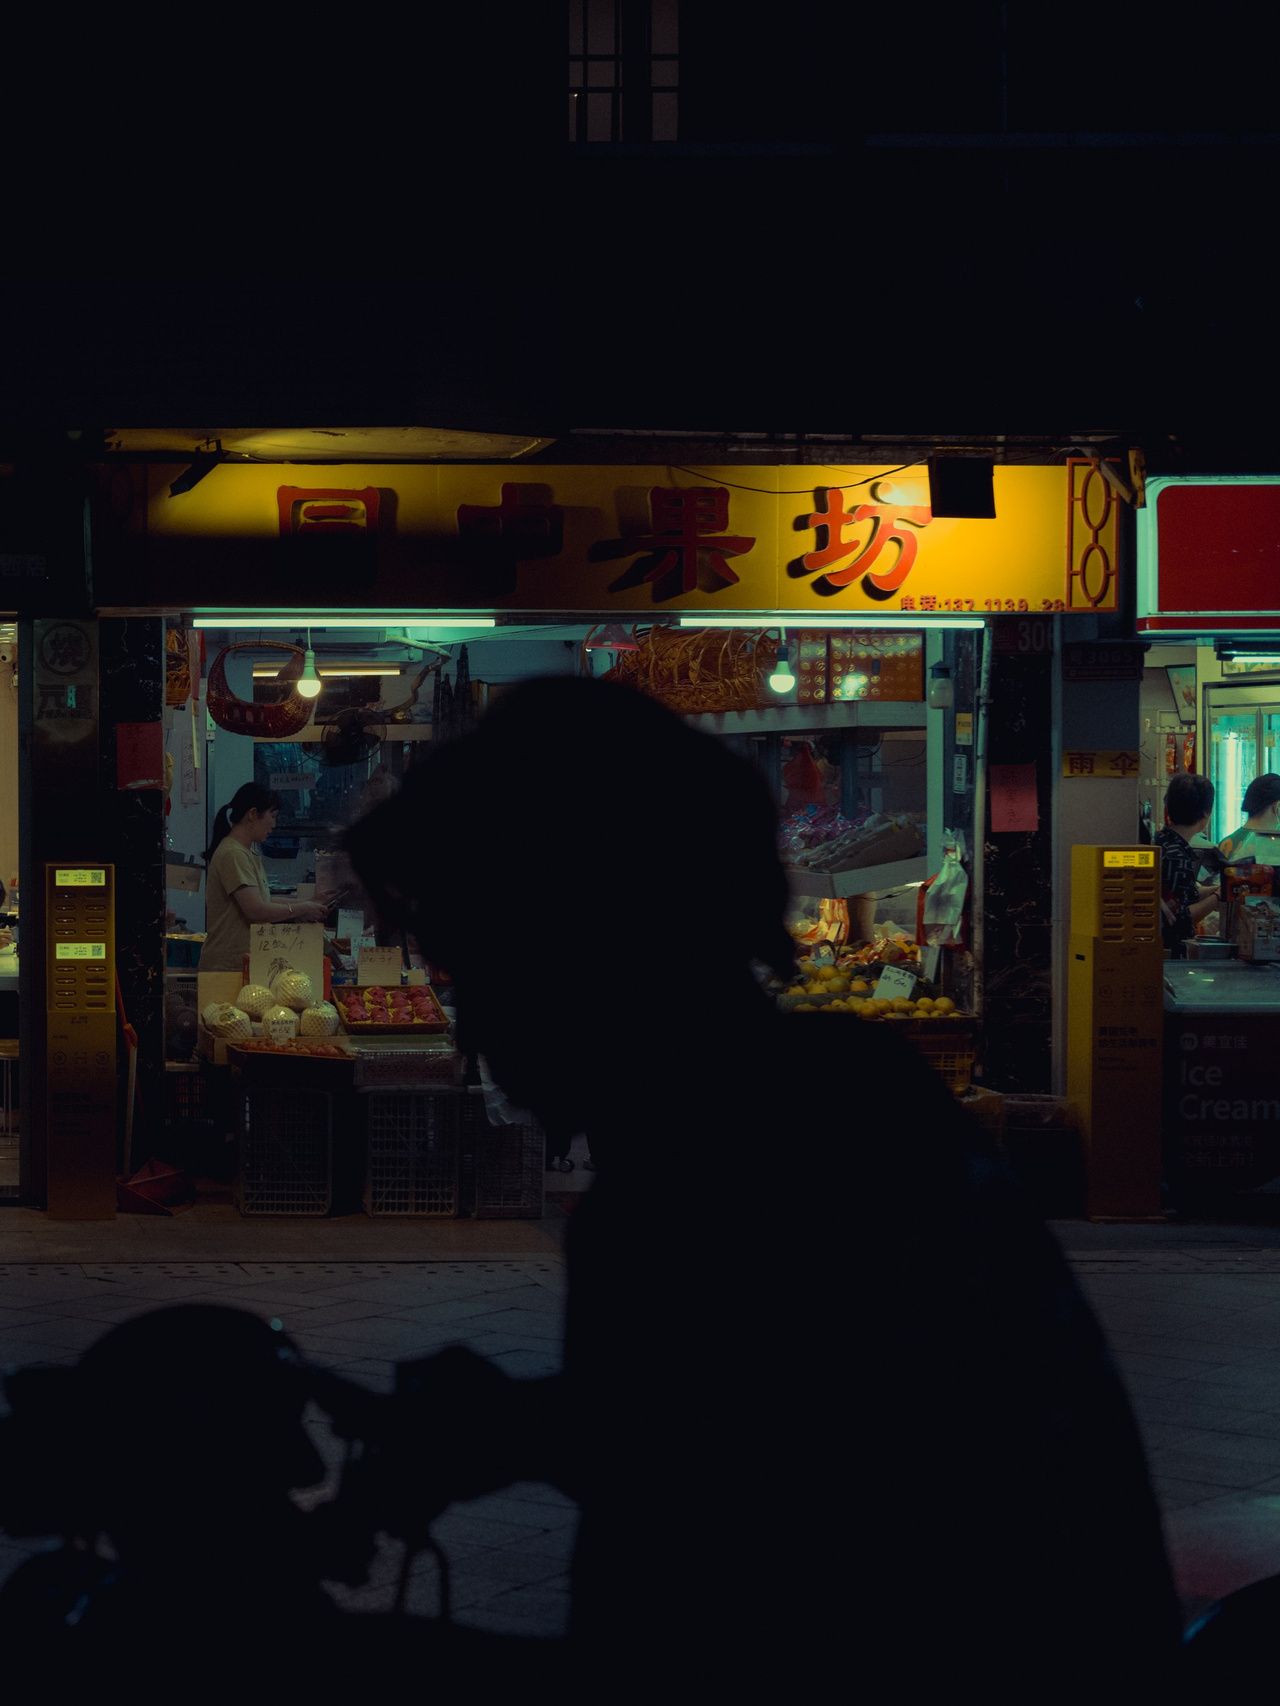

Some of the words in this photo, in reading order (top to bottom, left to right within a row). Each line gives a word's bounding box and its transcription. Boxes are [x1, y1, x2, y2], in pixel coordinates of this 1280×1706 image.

[1066, 752, 1139, 775] 雨伞
[1202, 1034, 1248, 1049] 美宜佳
[1180, 1059, 1224, 1087] Ice
[1179, 1093, 1280, 1121] Cream
